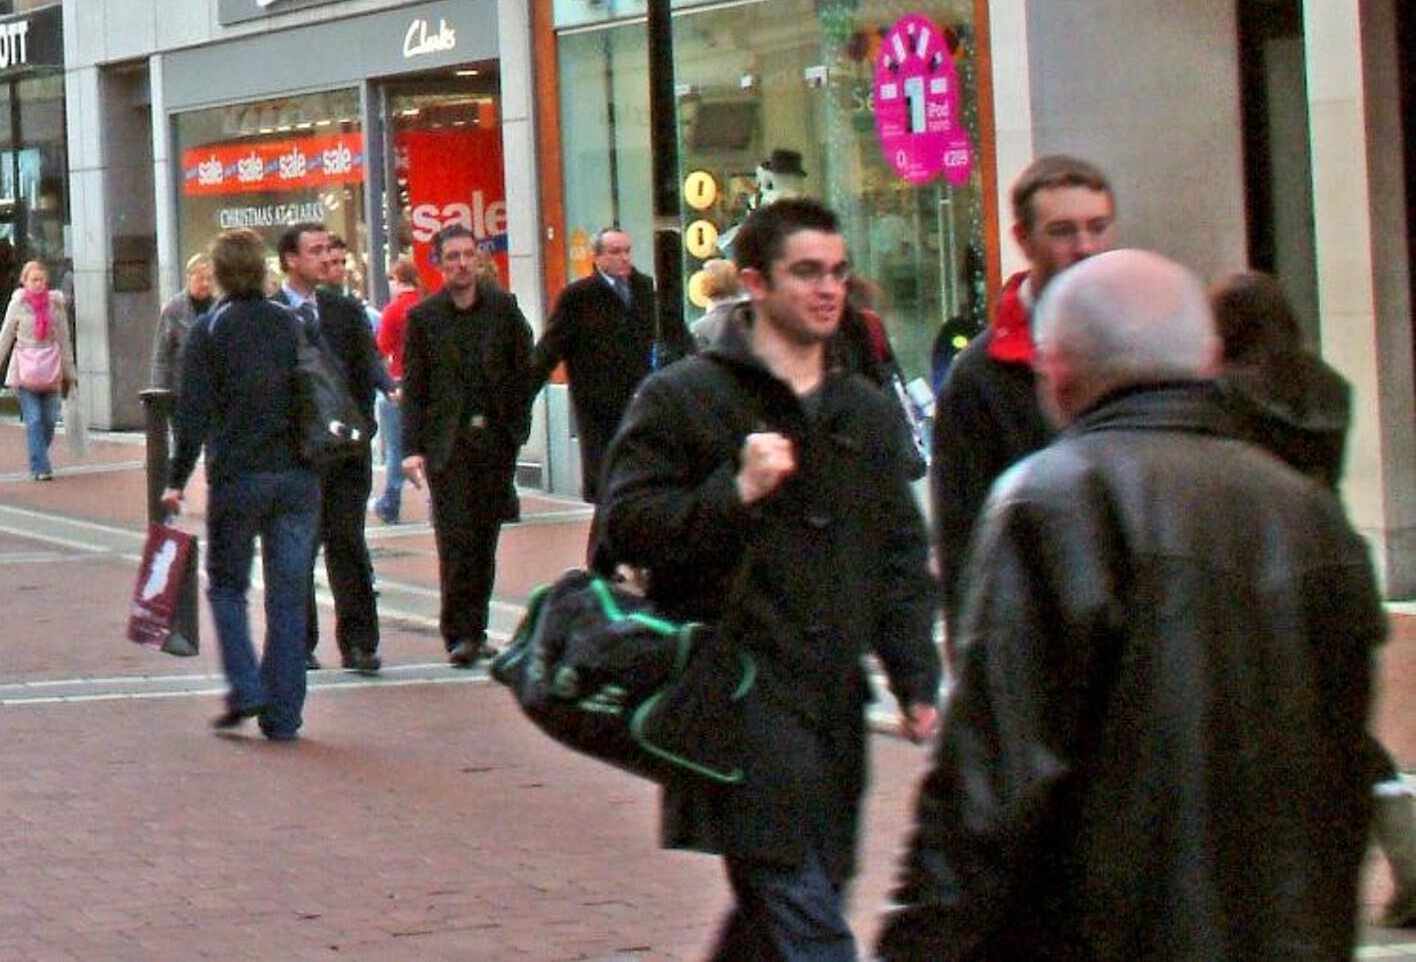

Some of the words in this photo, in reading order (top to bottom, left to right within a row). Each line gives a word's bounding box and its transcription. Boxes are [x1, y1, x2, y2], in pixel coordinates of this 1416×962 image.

[403, 18, 457, 58] Clarks
[197, 153, 223, 186] sale
[237, 150, 264, 182] sale
[278, 142, 306, 180] sale
[322, 140, 351, 176] sale
[219, 205, 273, 229] CHRISTMAS
[412, 189, 508, 243] sale
